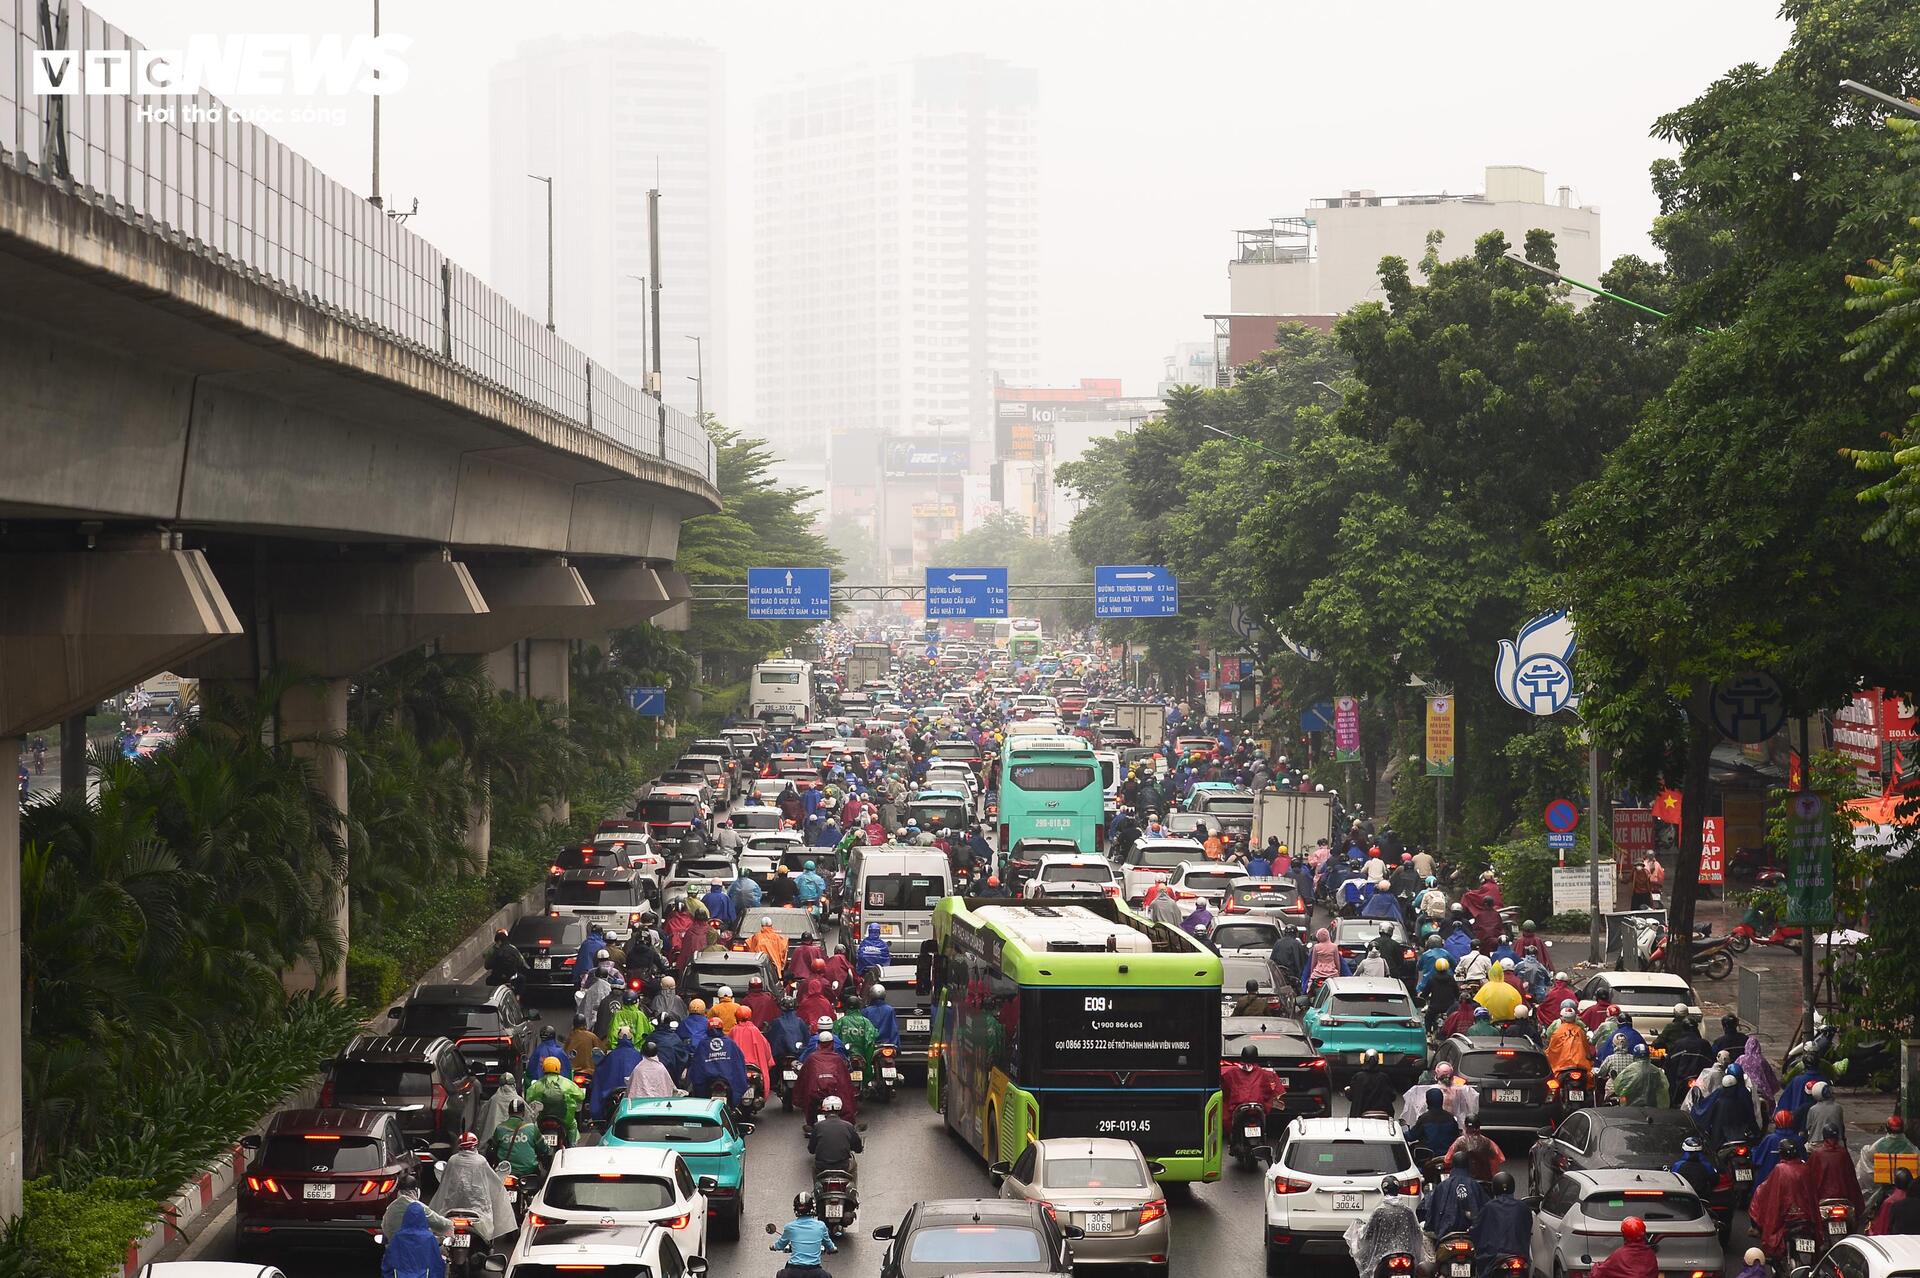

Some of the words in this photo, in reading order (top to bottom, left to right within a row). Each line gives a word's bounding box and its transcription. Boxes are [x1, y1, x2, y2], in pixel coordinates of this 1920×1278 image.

[1616, 828, 1628, 843] XE
[1085, 997, 1106, 1011] E09
[842, 1025, 865, 1036] Grab
[1055, 1041, 1065, 1051] GỌI
[1066, 1040, 1081, 1049] 0866
[1083, 1040, 1094, 1049] 355
[1095, 1040, 1107, 1049] 222
[1126, 1040, 1143, 1049] THÀNH
[1144, 1040, 1158, 1049] NHÂN
[1159, 1040, 1171, 1049] VIÊN
[1100, 1120, 1150, 1132] 29F-019.45
[502, 1133, 527, 1143] Grab
[1092, 1214, 1106, 1222] 30E
